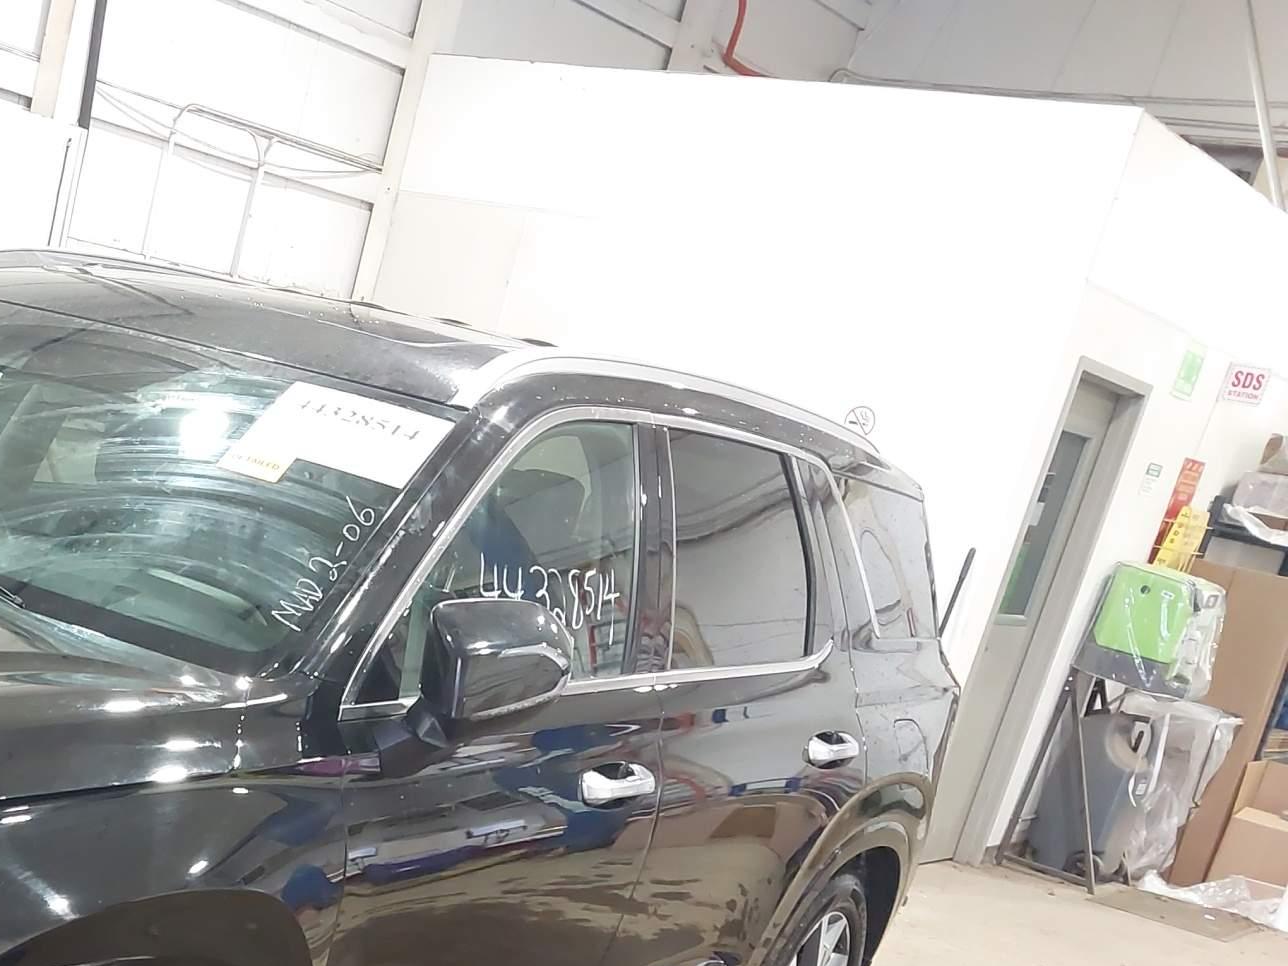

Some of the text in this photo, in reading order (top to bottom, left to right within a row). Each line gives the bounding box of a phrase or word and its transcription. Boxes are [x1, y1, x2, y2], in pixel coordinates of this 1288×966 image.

[1227, 389, 1259, 400] STATION
[1231, 370, 1265, 391] SDS
[298, 400, 421, 441] 44328514
[308, 496, 376, 582] 2-06
[479, 551, 621, 646] 44328514
